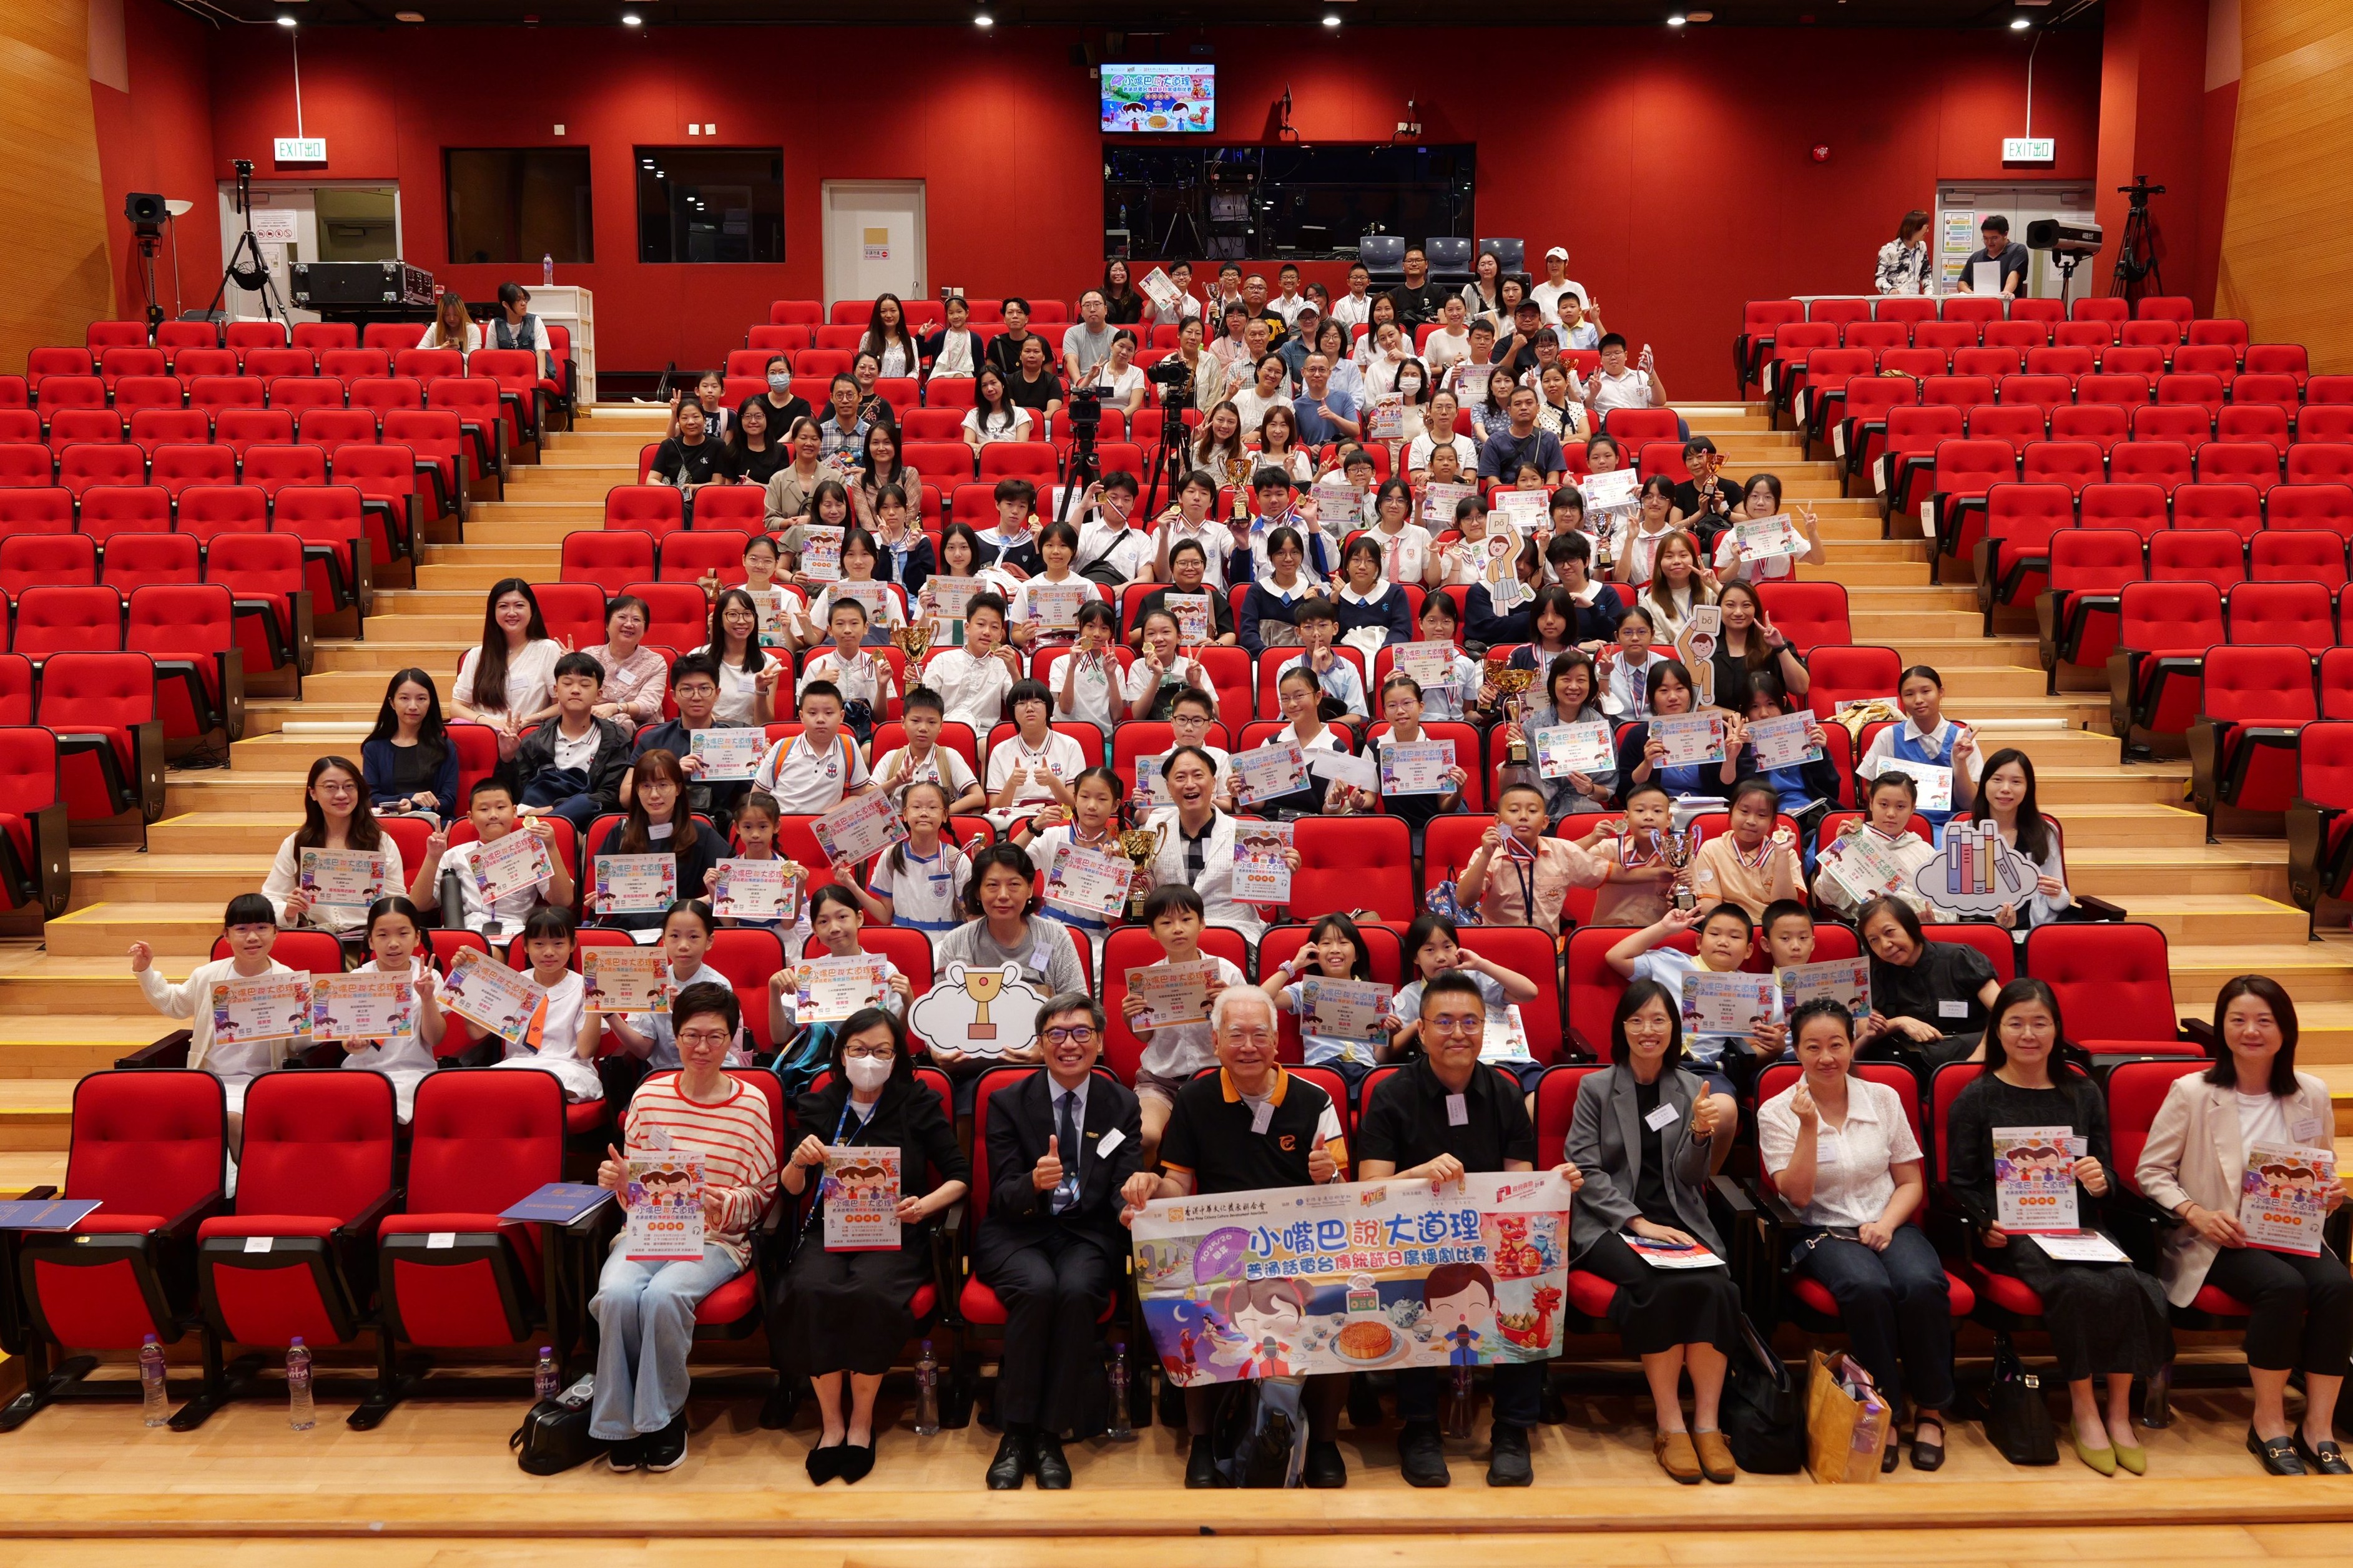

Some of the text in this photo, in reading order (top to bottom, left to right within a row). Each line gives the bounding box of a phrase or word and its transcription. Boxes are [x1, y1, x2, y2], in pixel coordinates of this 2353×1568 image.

[280, 142, 320, 157] EXIT 出口
[2009, 142, 2048, 157] EXIT 出口
[1495, 519, 1504, 527] pō
[1250, 1209, 1480, 1257] 小嘴巴說大道理
[1201, 1234, 1232, 1262] 2025/26
[1212, 1245, 1229, 1260] 學年
[1247, 1246, 1487, 1278] 普通話電台傳統節日廣播劇比賽
[288, 1367, 308, 1378] vita
[536, 1377, 557, 1390] vita
